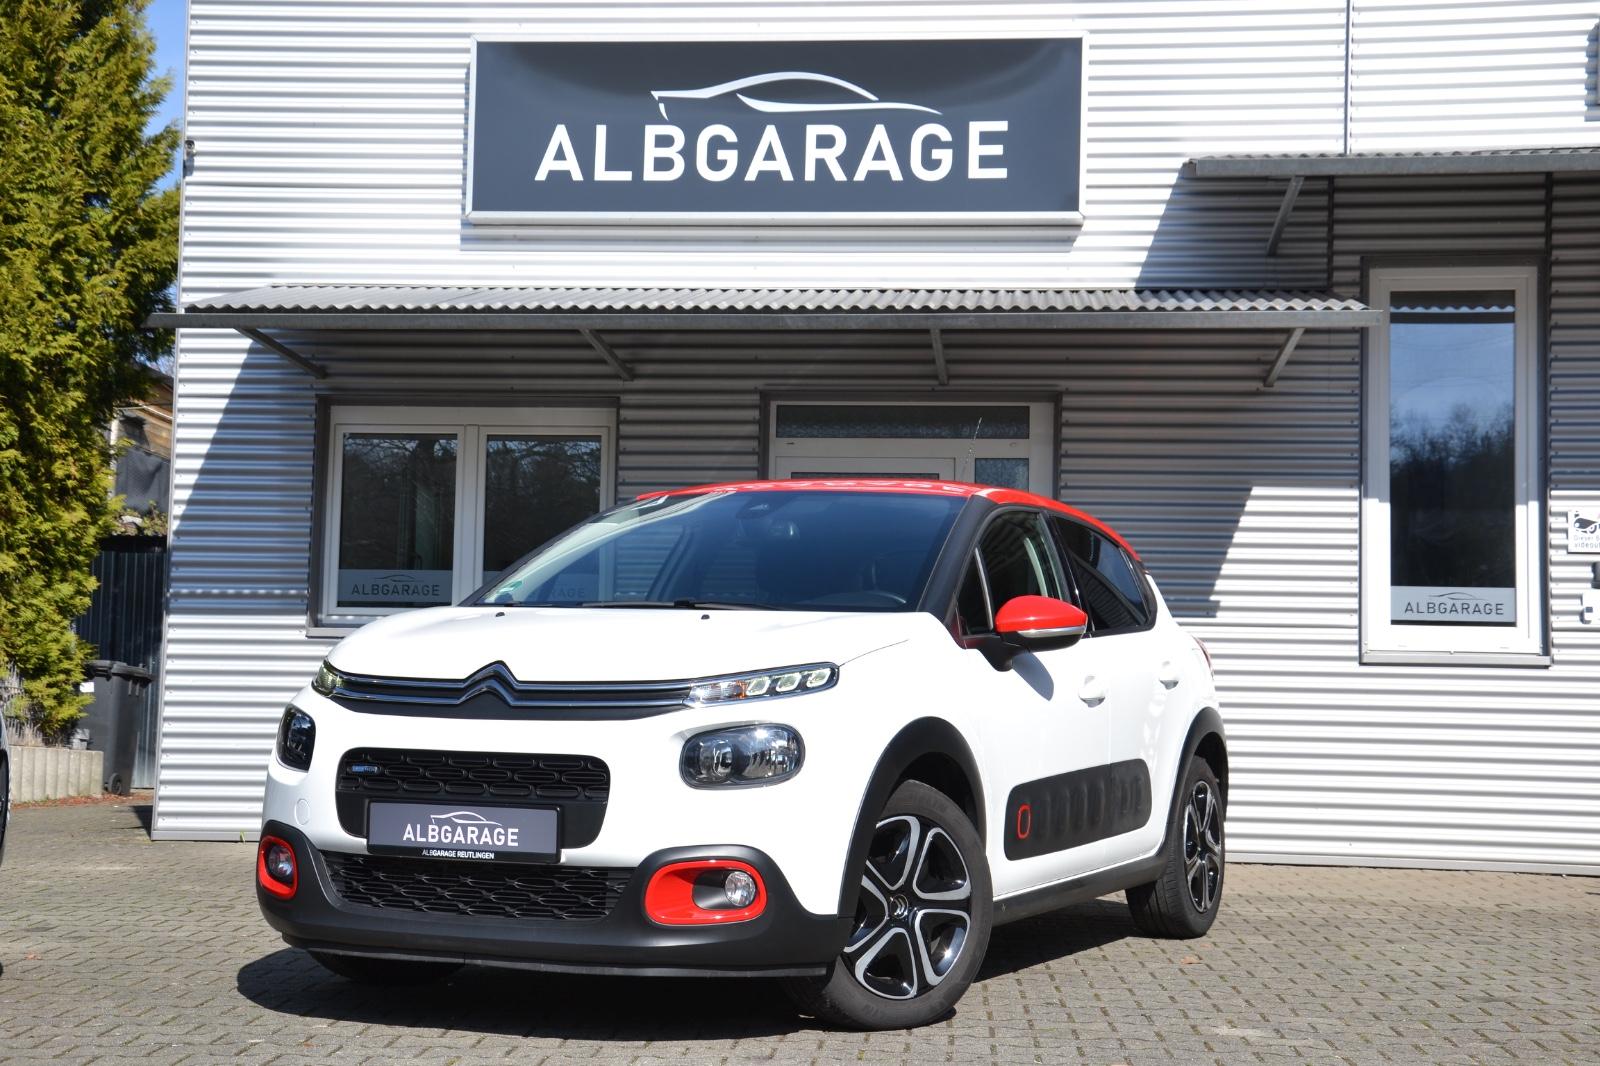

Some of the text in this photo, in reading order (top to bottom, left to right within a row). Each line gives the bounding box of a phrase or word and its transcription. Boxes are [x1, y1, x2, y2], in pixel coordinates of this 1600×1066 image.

[534, 120, 1009, 182] ALBGARAGE
[351, 584, 441, 596] ALBGARAGE
[1404, 602, 1505, 615] ALBGARAGE
[402, 823, 519, 847] ALBGARAGE
[422, 849, 495, 860] ALBGARAGE REUTLINGEN
